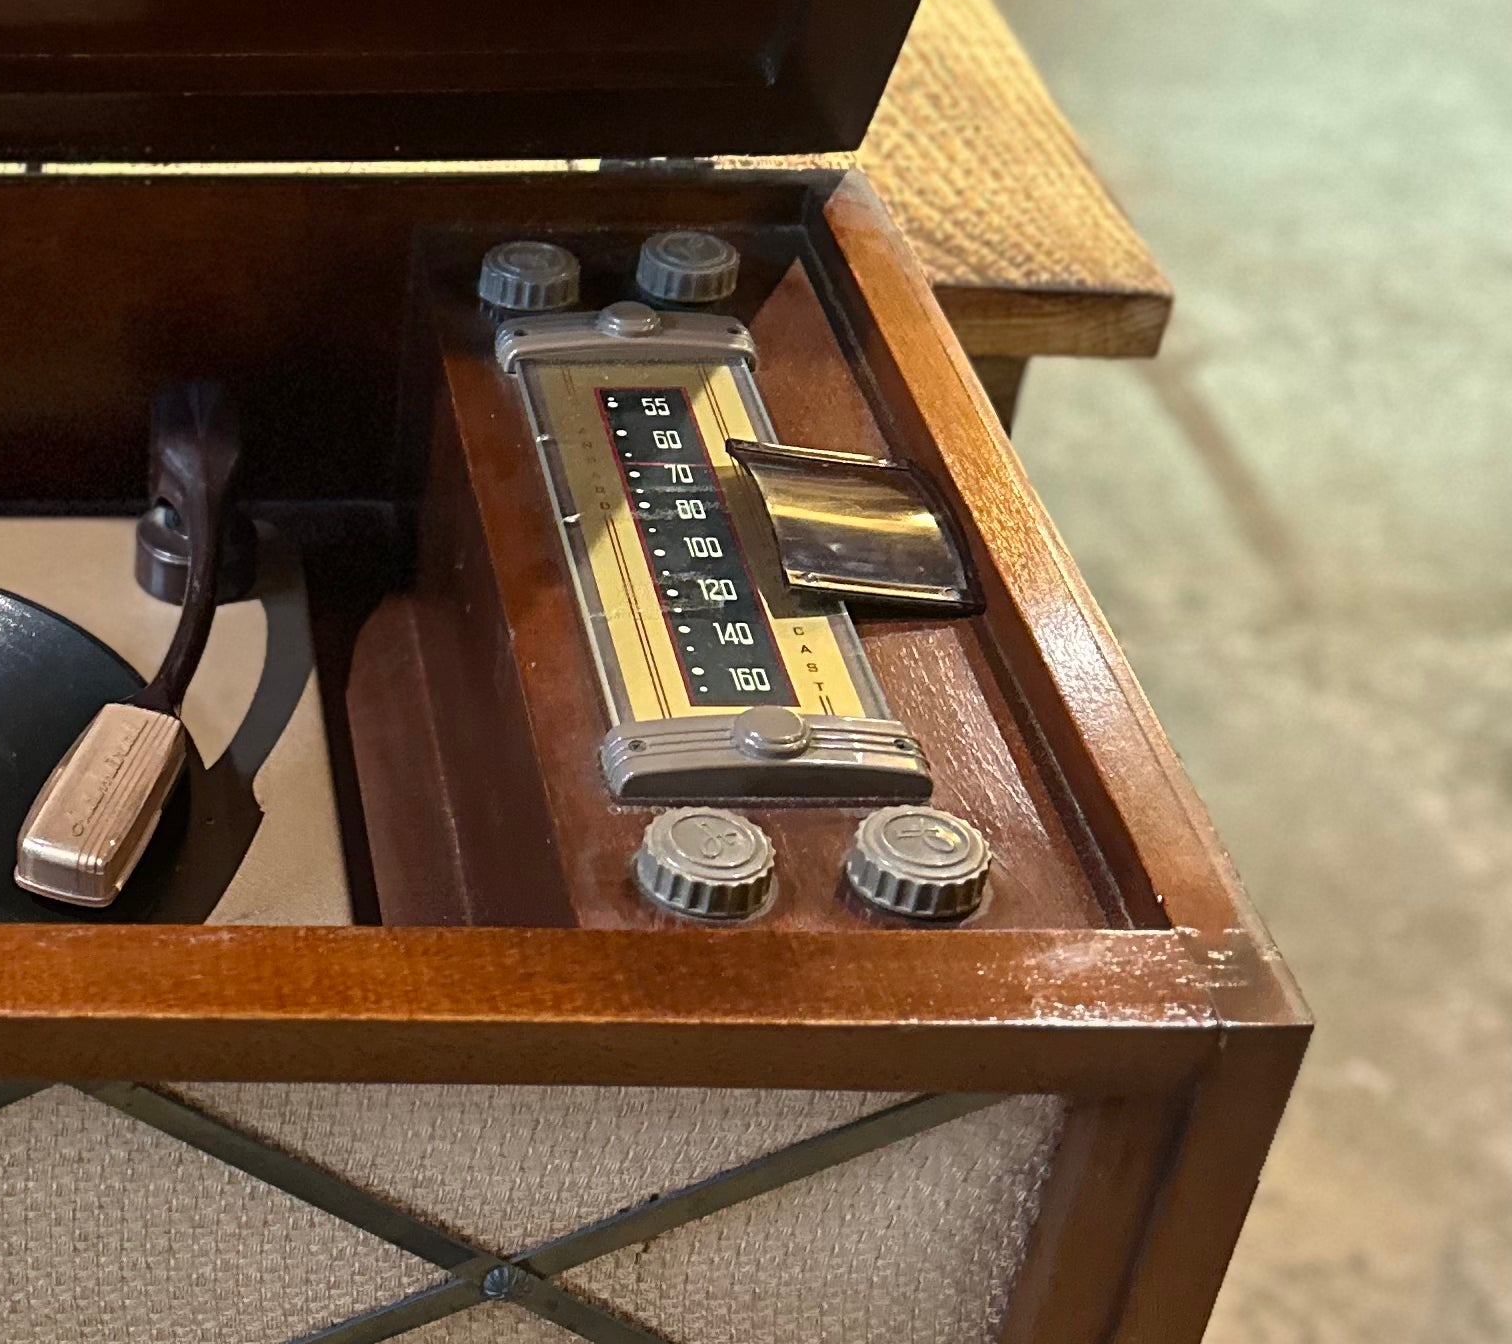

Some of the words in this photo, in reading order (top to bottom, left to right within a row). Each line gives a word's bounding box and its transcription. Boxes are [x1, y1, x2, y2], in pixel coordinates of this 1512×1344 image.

[641, 397, 671, 416] 55
[652, 430, 683, 449] 60
[663, 464, 694, 483] 70
[675, 499, 707, 520] 80
[683, 537, 723, 558] 100
[697, 579, 738, 601] 120
[712, 622, 754, 645] 140
[728, 668, 771, 691] 160
